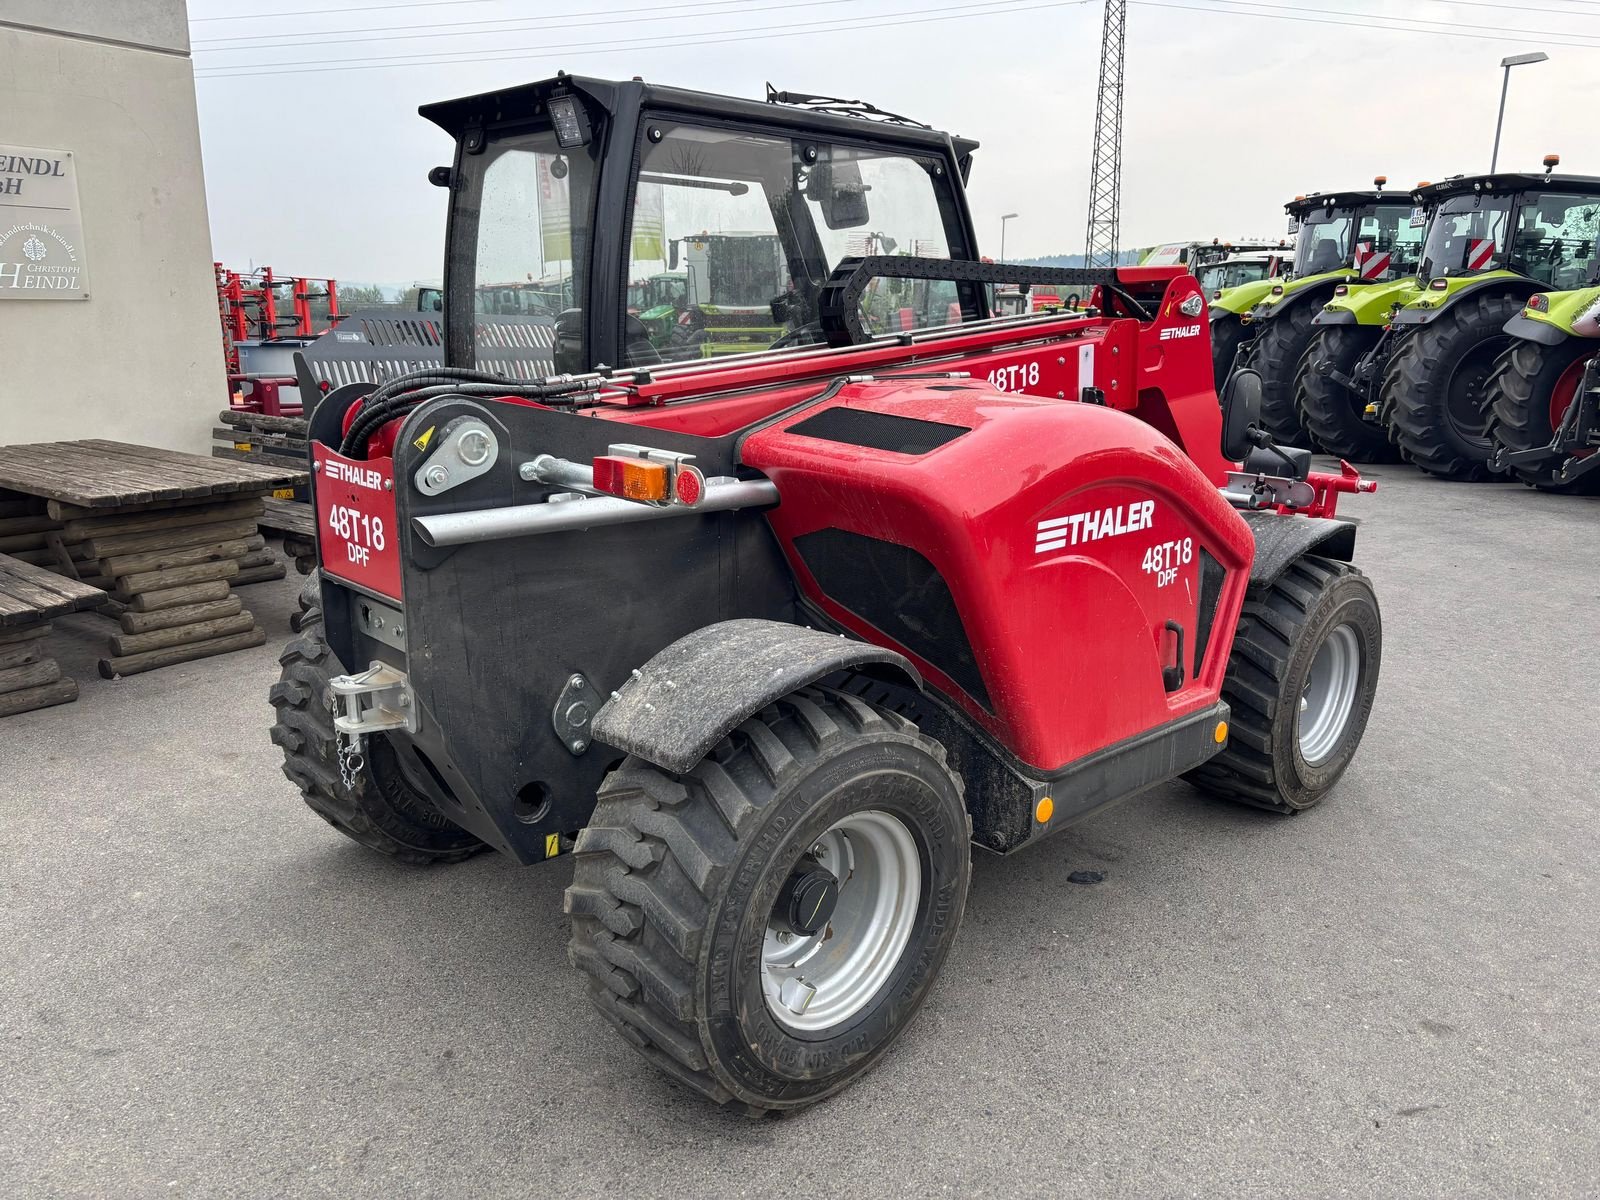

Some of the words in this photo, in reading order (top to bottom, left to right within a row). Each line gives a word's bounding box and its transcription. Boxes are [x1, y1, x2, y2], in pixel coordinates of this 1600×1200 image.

[27, 263, 80, 274] CHRISTOPH
[1167, 324, 1201, 339] THALER
[987, 362, 1040, 392] 48T18
[334, 462, 382, 491] THALER
[329, 504, 385, 551] 48T18
[1062, 499, 1155, 547] THALER
[347, 542, 370, 567] DPF
[1141, 537, 1193, 574] 48T18
[1157, 567, 1179, 588] DPF
